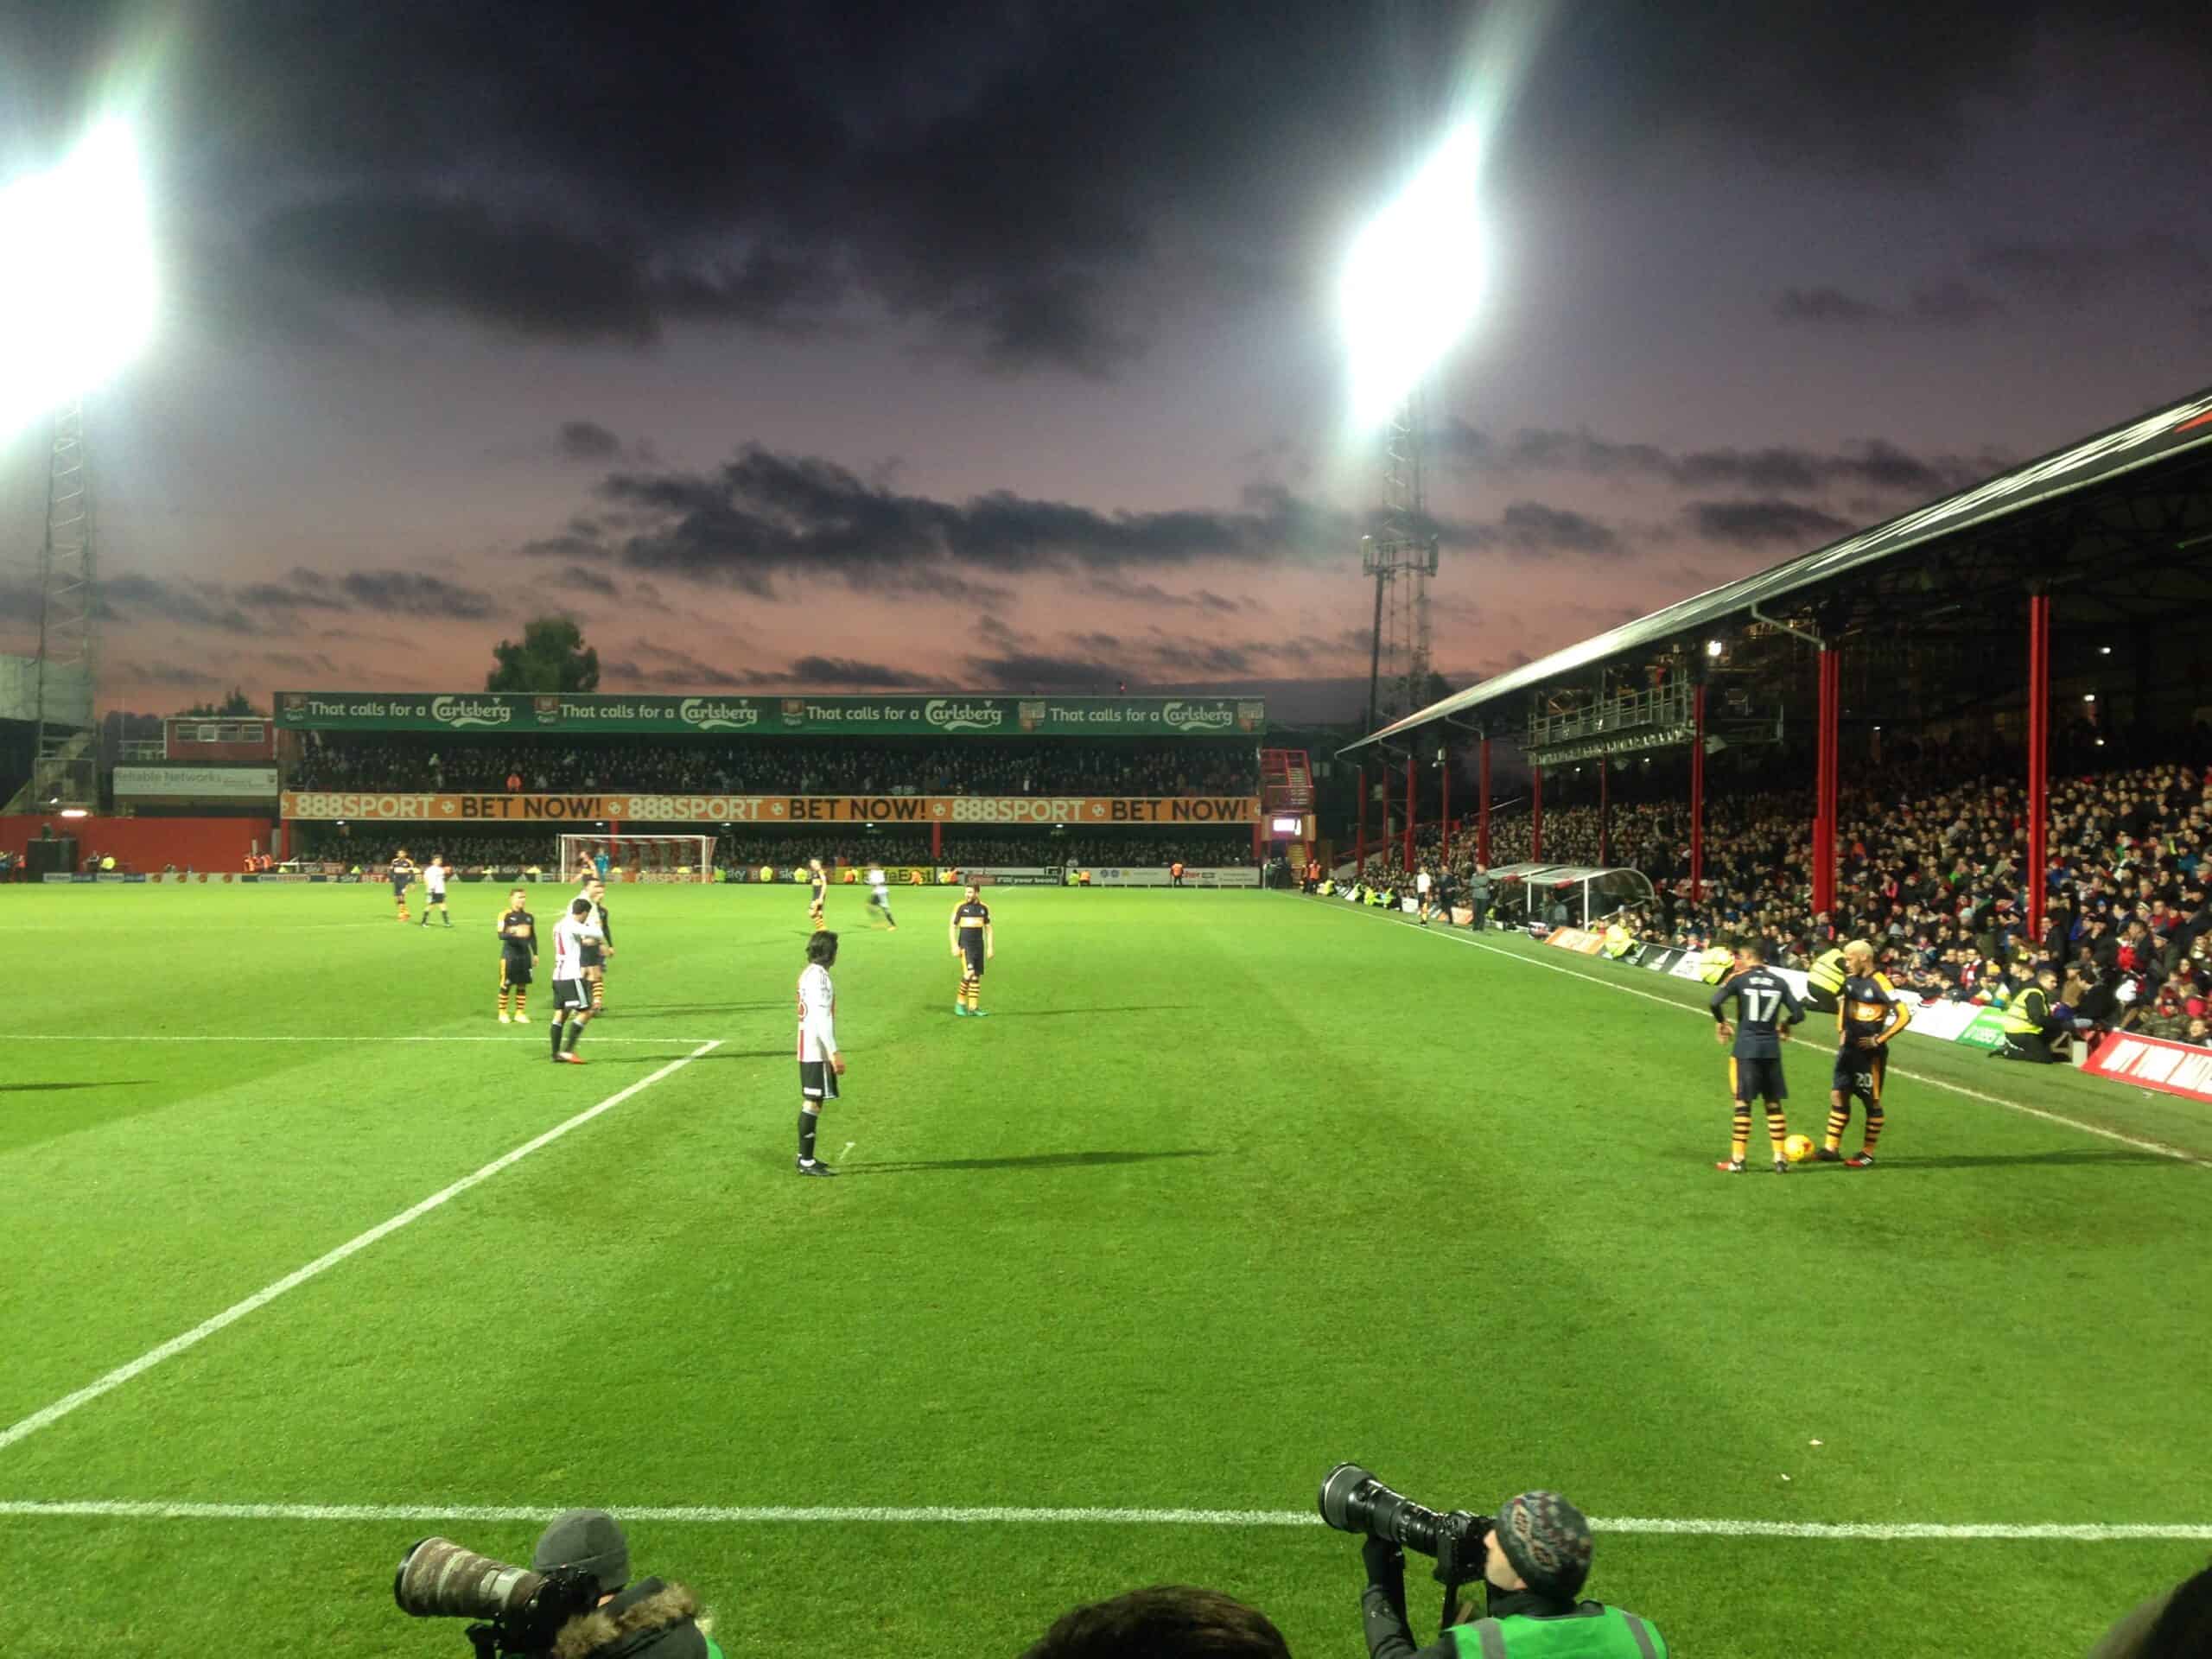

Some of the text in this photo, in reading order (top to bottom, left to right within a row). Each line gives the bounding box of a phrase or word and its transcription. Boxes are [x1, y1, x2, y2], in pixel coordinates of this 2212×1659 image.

[309, 696, 511, 727] That calls for a Carlsberg
[560, 698, 758, 729] That calls for a Carlsberg
[806, 700, 1002, 731] That calls for a Carlsberg
[1050, 702, 1233, 731] That calls for a Carlsberg
[296, 794, 601, 818] 888SPORT BET NOW!
[628, 797, 926, 820] 888SPORT BET NOW!
[951, 799, 1248, 822] 888SPORT BET NOW!
[1743, 988, 1783, 1022] 17
[1854, 1071, 1873, 1087] 20
